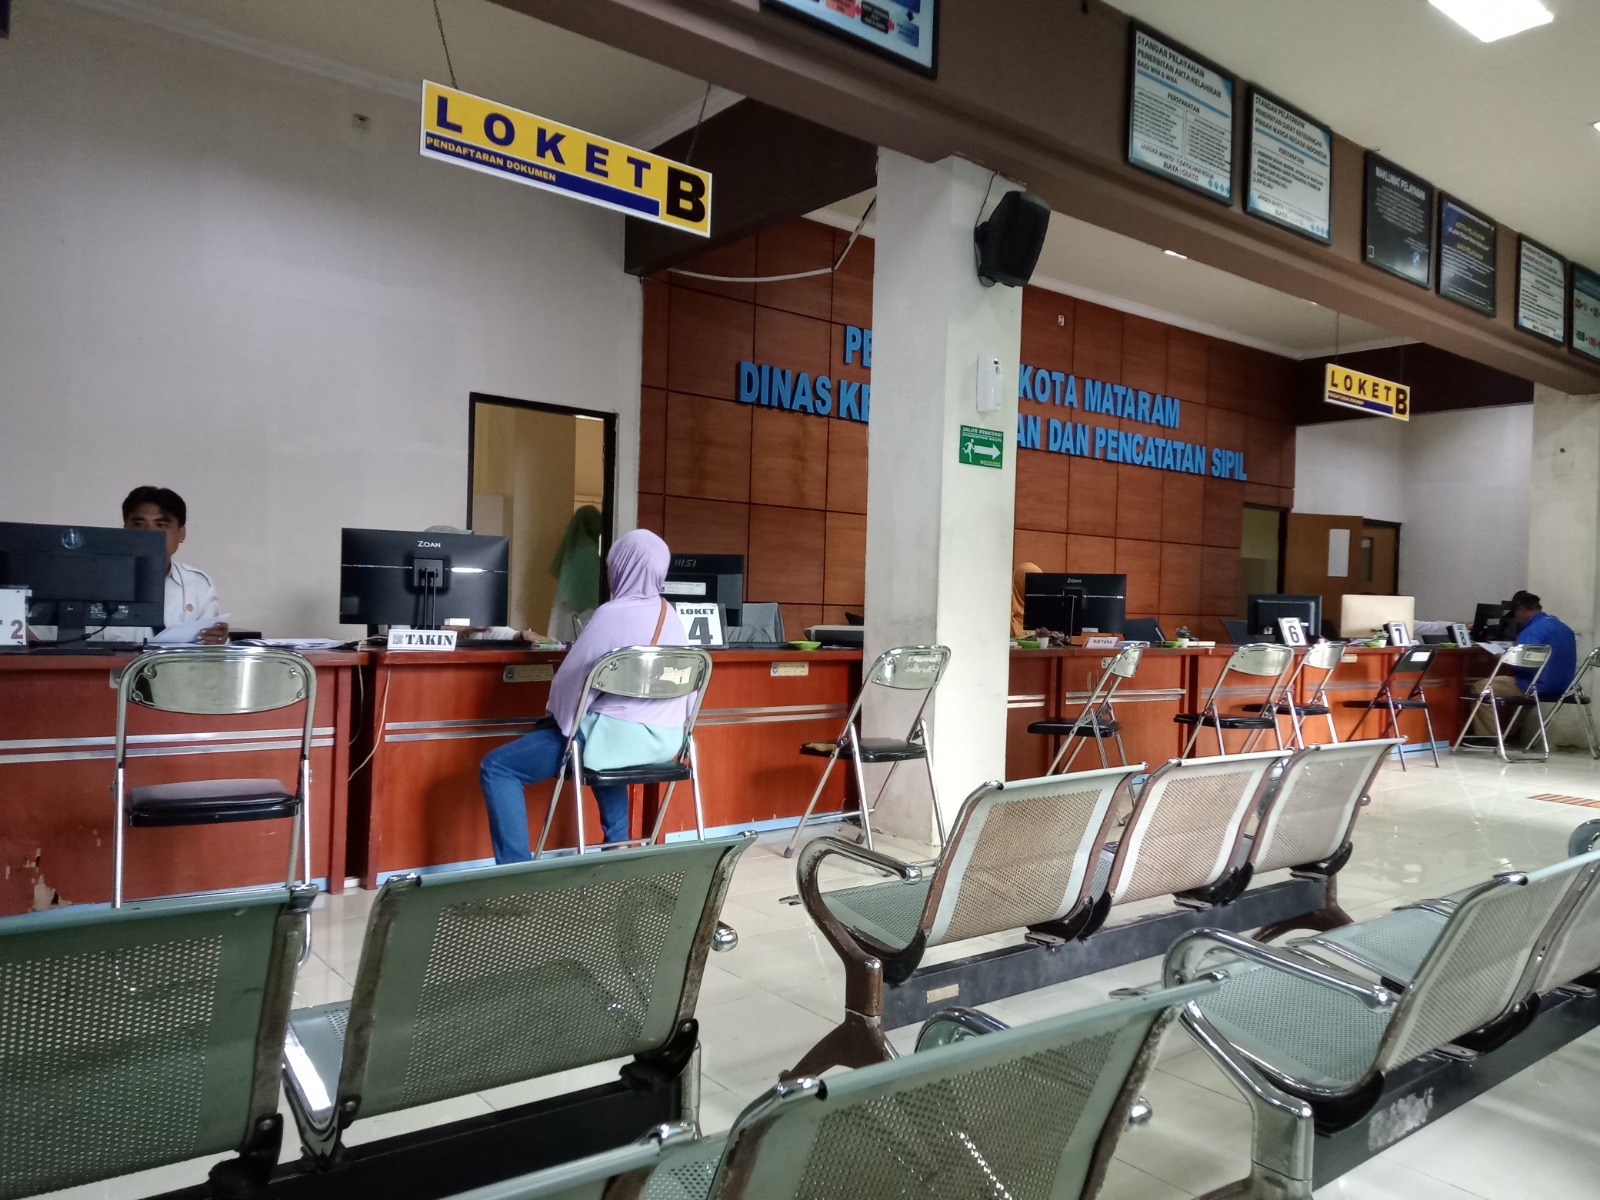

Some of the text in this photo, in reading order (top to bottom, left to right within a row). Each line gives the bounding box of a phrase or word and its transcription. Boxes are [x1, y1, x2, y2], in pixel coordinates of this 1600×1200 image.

[1137, 48, 1222, 98] PENERBITAN AKTA KELAHIRAN
[1138, 35, 1205, 78] STANDAR PELAYANAN
[426, 136, 556, 182] PENDAFTARAN DOKUMEN
[436, 95, 706, 223] LOKET B
[1018, 363, 1079, 409] KOTA
[1084, 378, 1181, 429] MATARAM
[1330, 370, 1392, 402] LOKET
[1395, 386, 1408, 416] B
[737, 361, 832, 415] DINAS
[1048, 418, 1090, 457] DAN
[1094, 426, 1207, 476] PENCATATAN
[1210, 447, 1248, 481] SIPIL
[417, 540, 441, 548] ZOAN
[10, 619, 24, 640] 2
[405, 634, 454, 646] TAKIN
[688, 616, 713, 644] 4
[1288, 624, 1300, 644] 6
[1394, 627, 1403, 644] 7
[1459, 630, 1467, 646] 8
